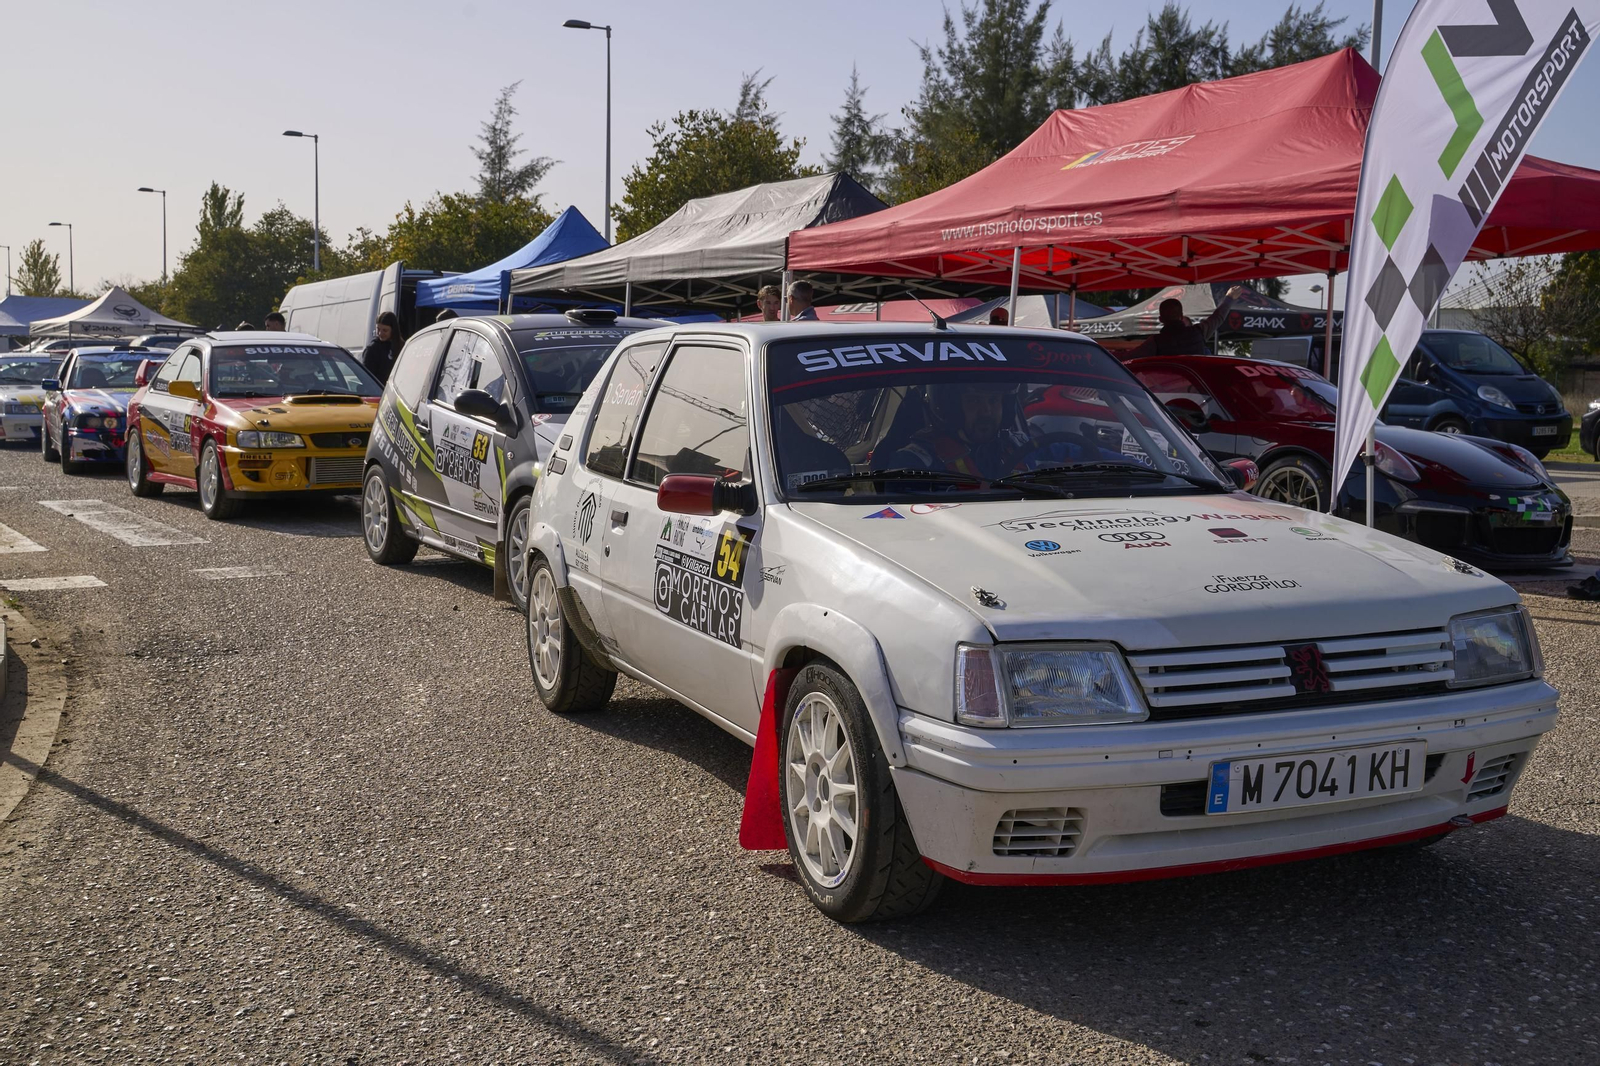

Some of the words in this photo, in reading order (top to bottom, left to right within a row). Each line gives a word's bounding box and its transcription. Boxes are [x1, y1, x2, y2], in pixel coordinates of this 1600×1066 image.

[1490, 19, 1582, 172] MOTORSPORT
[941, 210, 1103, 241] www.nsmotorsport.es
[91, 324, 123, 333] 24MX
[1080, 320, 1123, 333] 24MX
[1243, 316, 1286, 329] 24MX
[244, 346, 320, 355] SUBARU
[796, 341, 1008, 372] SERVAN
[1025, 341, 1097, 368] Sport
[239, 452, 273, 460] PIRELLI
[472, 432, 489, 461] 53
[443, 449, 481, 476] MORENO'S
[473, 500, 499, 517] SERVAN
[716, 528, 748, 582] 54
[1028, 549, 1082, 558] Volkswagen
[1124, 540, 1172, 549] Audi
[670, 567, 742, 620] MORENO'S
[1203, 580, 1302, 594] GORDOPILO!
[680, 597, 738, 647] CAPILAR
[1241, 763, 1264, 805] M
[1273, 754, 1357, 802] 7041
[1368, 748, 1411, 792] KH
[1213, 793, 1223, 805] E
